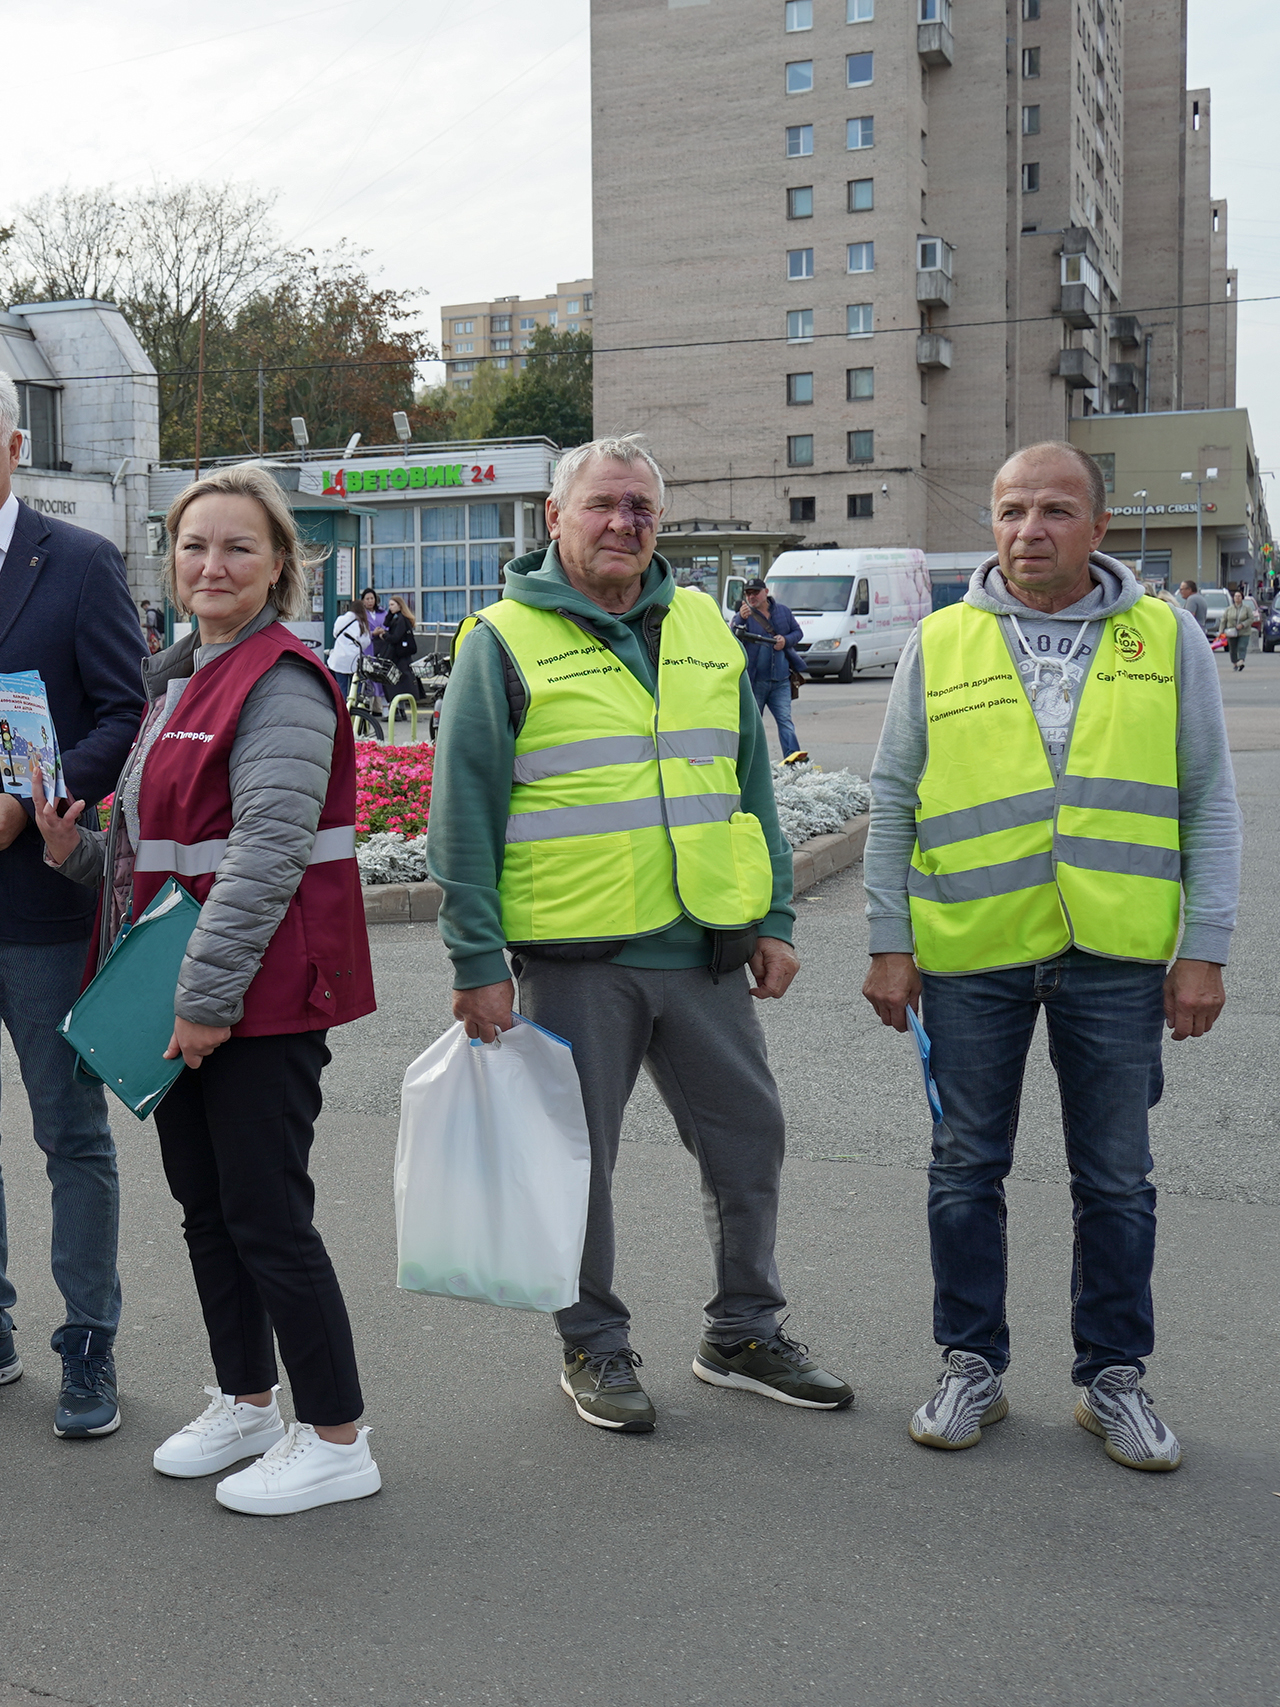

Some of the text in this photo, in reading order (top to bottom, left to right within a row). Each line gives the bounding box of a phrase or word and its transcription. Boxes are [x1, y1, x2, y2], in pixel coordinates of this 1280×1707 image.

[321, 463, 496, 498] ЦВЕТОВИК 24
[34, 498, 77, 515] ПРОСПЕКТ
[1106, 504, 1166, 516] ОРОШАЯ
[536, 648, 580, 667] Народная
[547, 666, 602, 684] Калининский
[926, 673, 1013, 698] Народная дружина
[928, 697, 1018, 723] Калининский район
